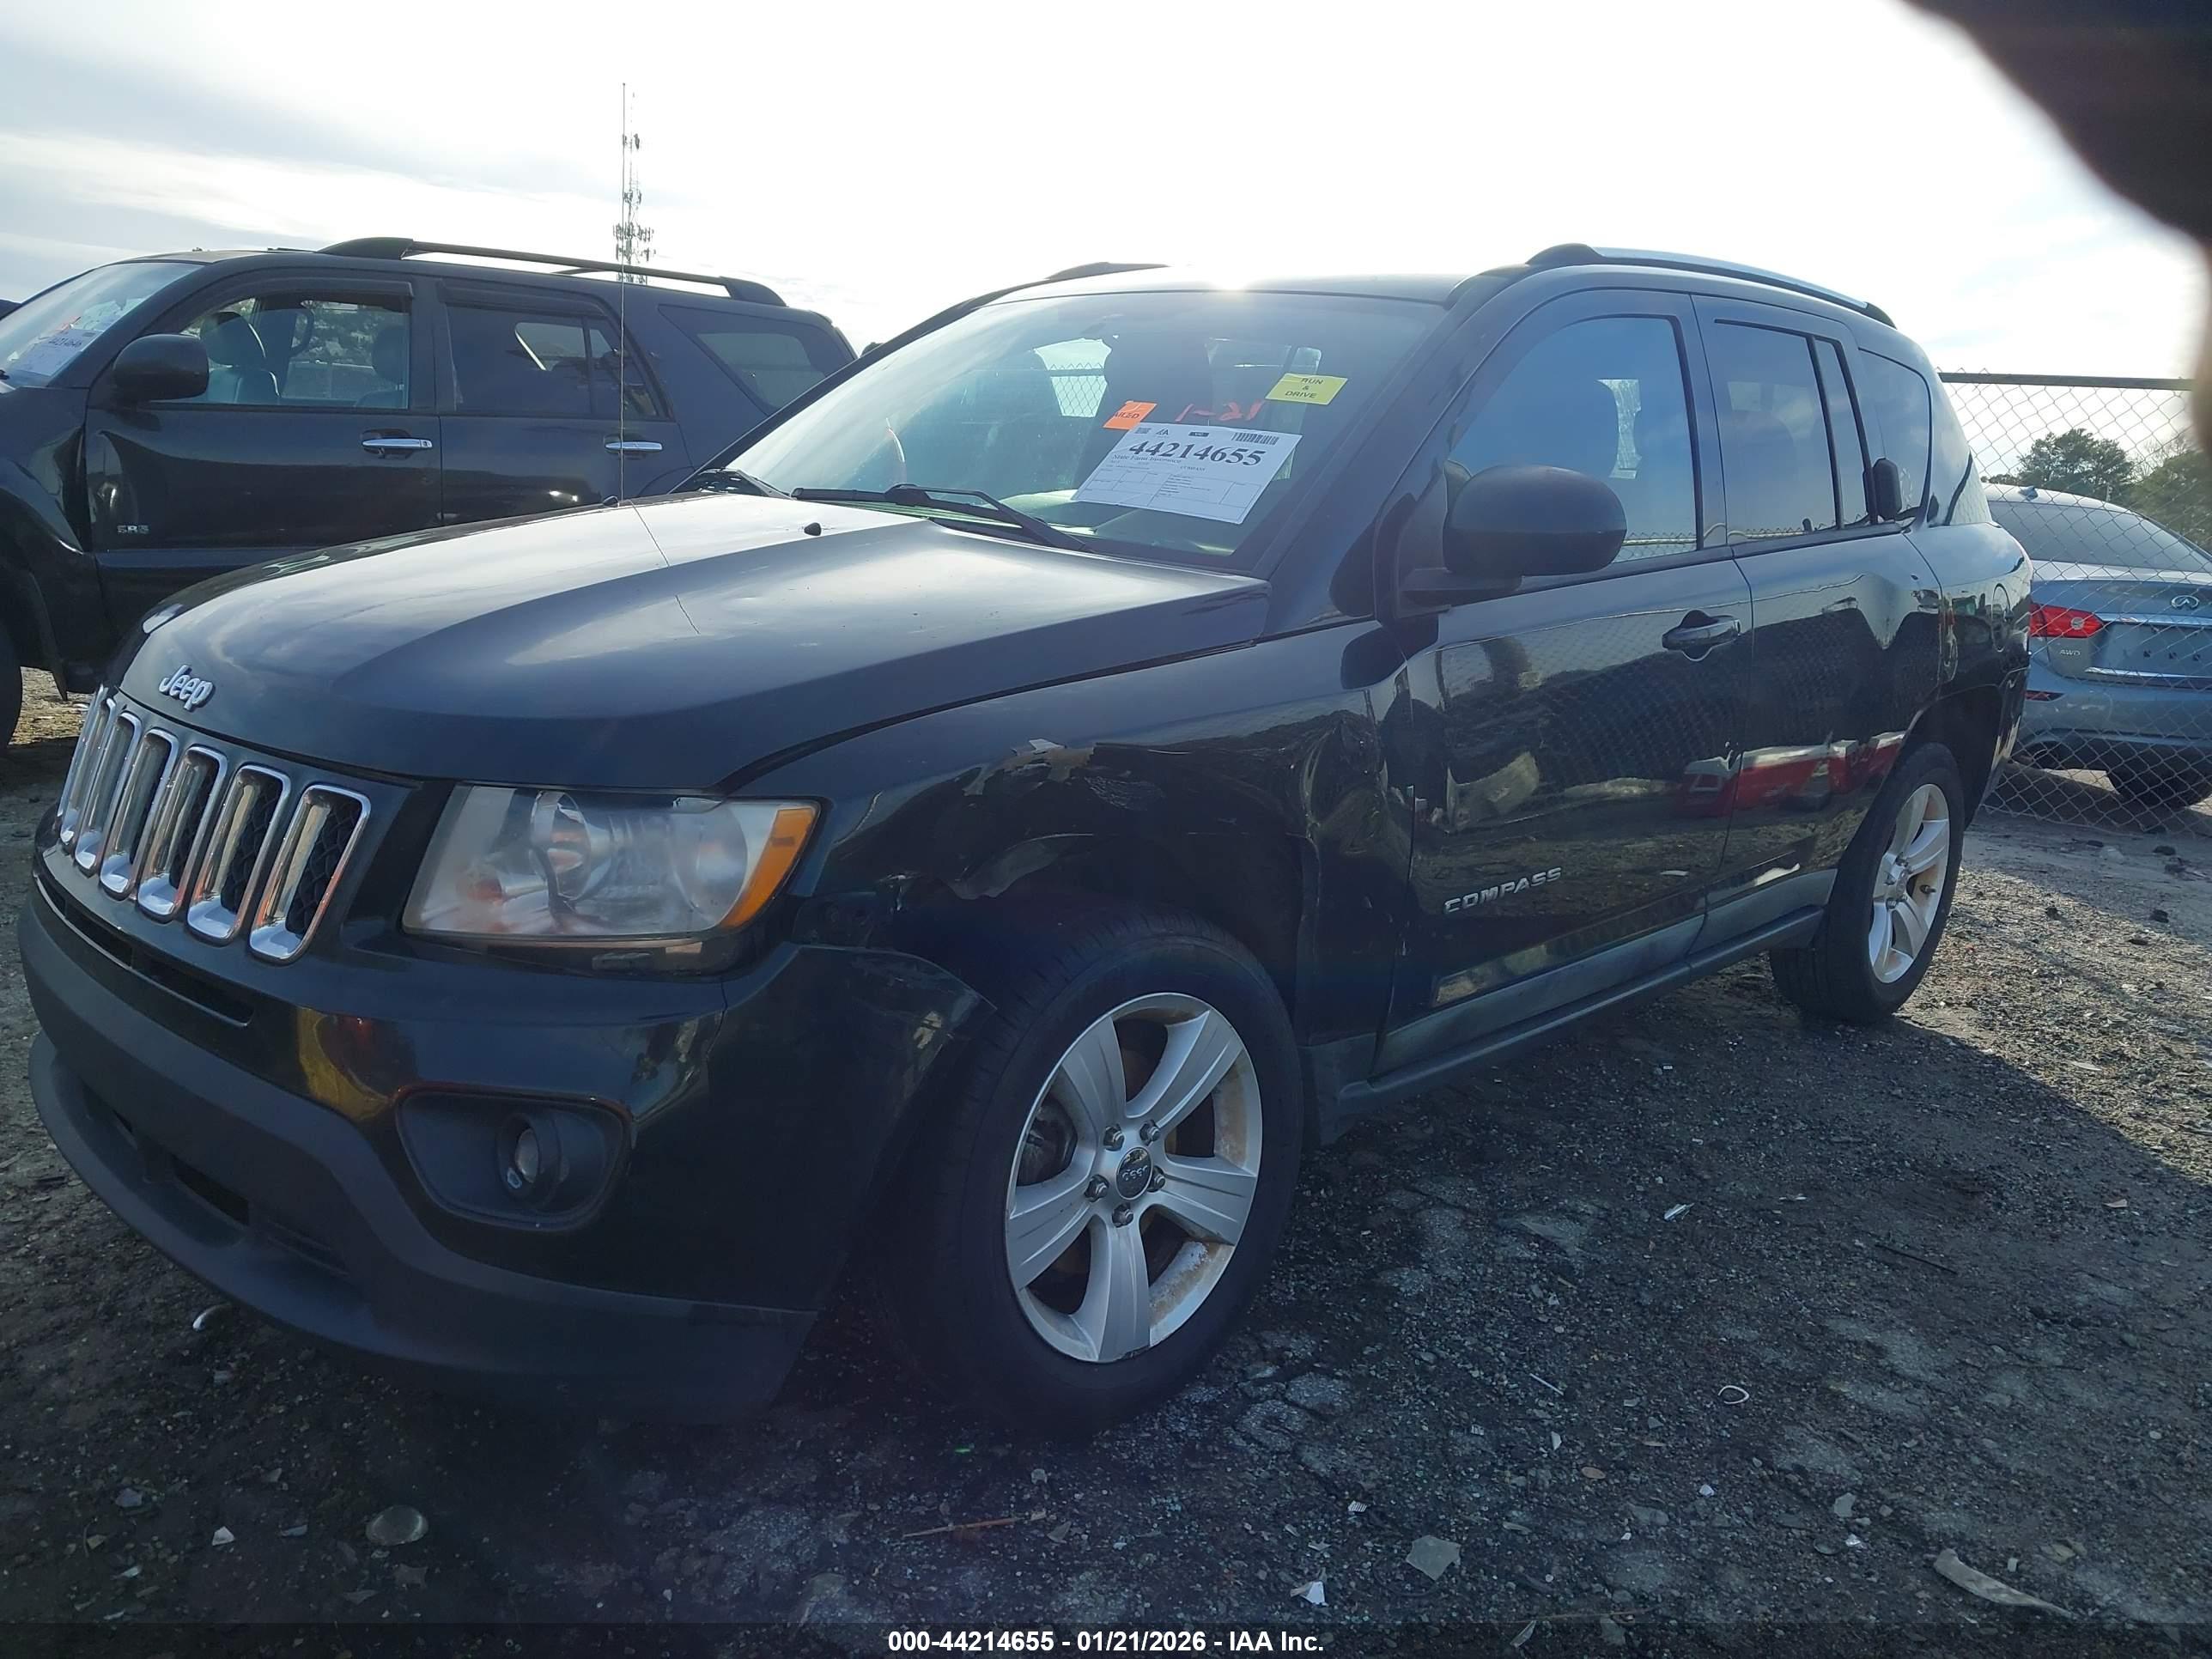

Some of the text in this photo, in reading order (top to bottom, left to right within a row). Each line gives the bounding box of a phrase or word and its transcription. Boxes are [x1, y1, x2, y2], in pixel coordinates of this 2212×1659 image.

[1129, 441, 1267, 465] 44214655
[159, 665, 214, 711] Jeep
[1444, 867, 1562, 913] COMPASS
